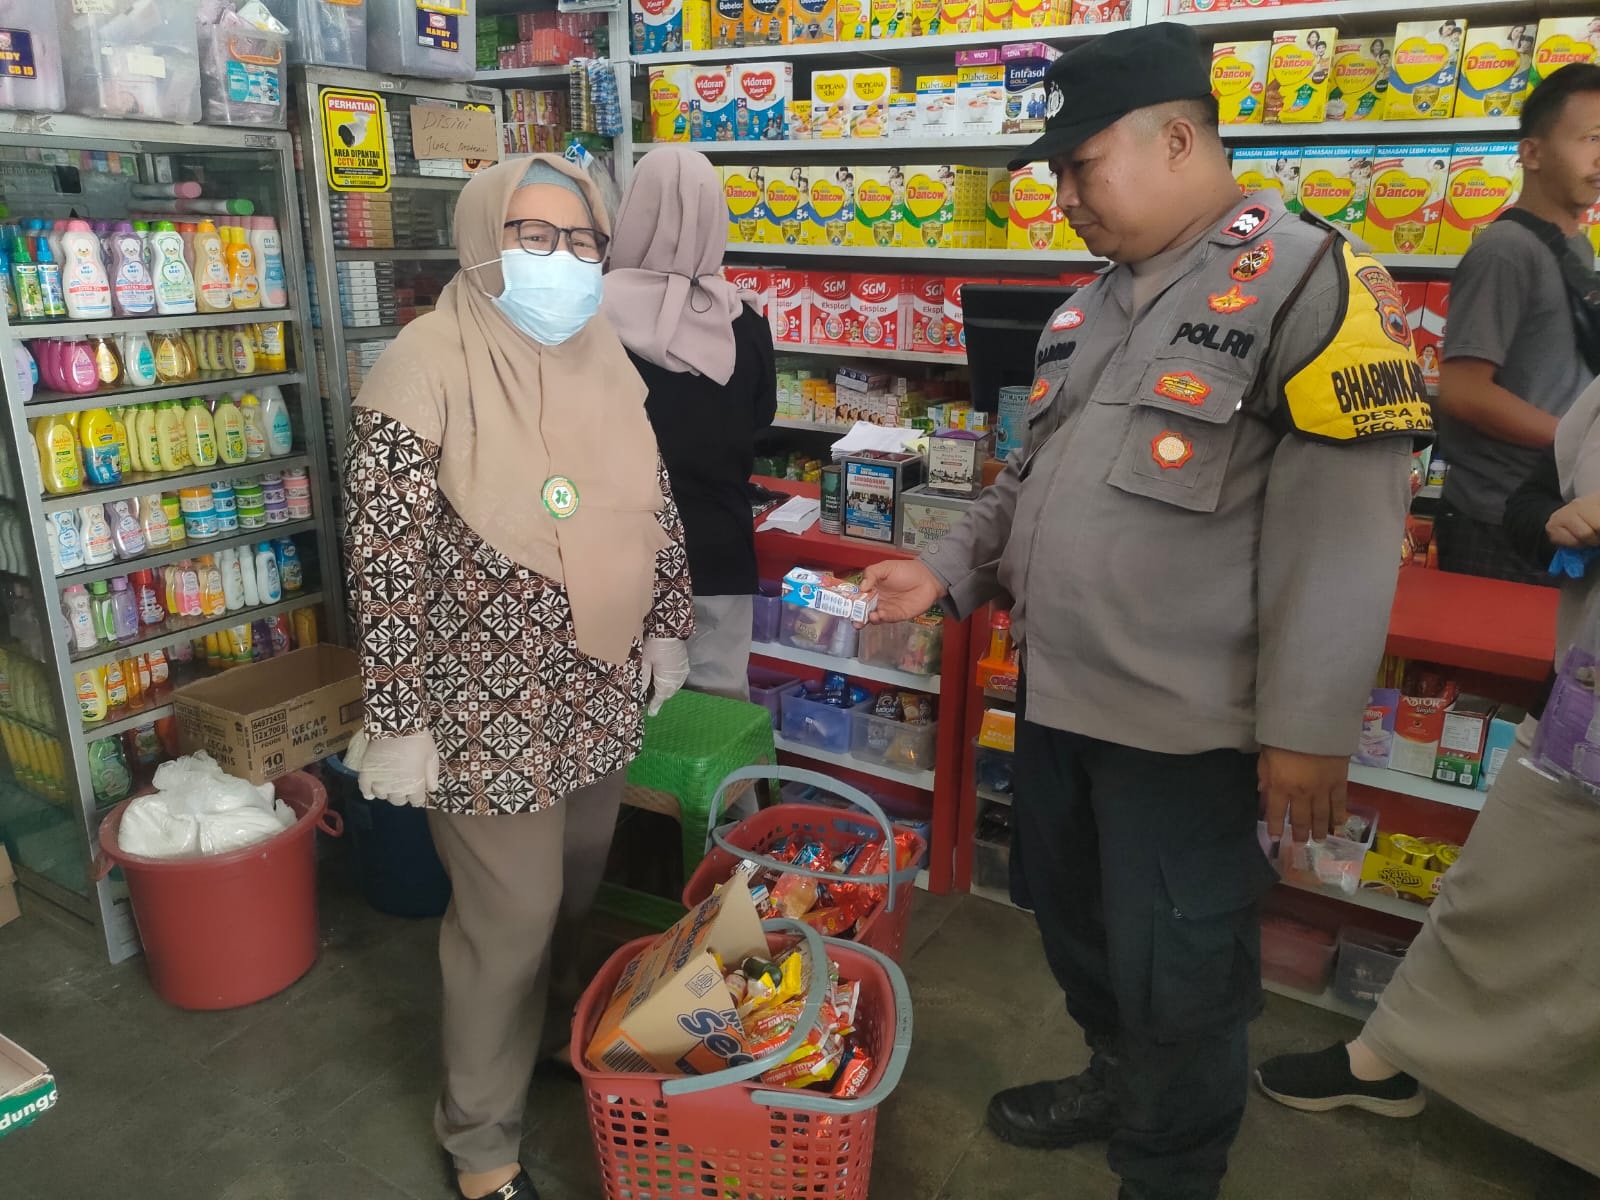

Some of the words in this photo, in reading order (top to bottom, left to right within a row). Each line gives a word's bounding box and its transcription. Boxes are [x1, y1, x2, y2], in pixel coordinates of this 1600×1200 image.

[1273, 56, 1313, 69] Dancow
[1396, 51, 1445, 65] Dancow
[1467, 56, 1517, 71] Dancow
[962, 72, 1000, 82] Diabetasol
[1010, 66, 1046, 79] Entrasol
[1214, 67, 1252, 79] Dancow
[1337, 65, 1377, 77] Dancow
[696, 79, 724, 89] vidoran
[743, 77, 773, 88] vidoran
[1437, 72, 1454, 85] 5+
[1509, 78, 1525, 90] 5+
[328, 99, 376, 112] PERHATIAN
[736, 99, 747, 108] 5+
[333, 149, 350, 158] AREA
[1235, 148, 1264, 158] KEMASAN
[1264, 148, 1282, 157] LEBIH
[1304, 147, 1335, 156] KEMASAN
[1336, 147, 1352, 156] LEBIH
[1352, 147, 1374, 156] HEMAT
[1377, 146, 1409, 156] KEMASAN
[1409, 146, 1428, 155] LEBIH
[1429, 146, 1450, 155] HEMAT
[1455, 145, 1488, 155] KEMASAN
[1488, 144, 1507, 154] LEBIH
[726, 186, 757, 198] Dancow
[908, 186, 945, 200] Dancow
[1014, 189, 1051, 202] Dancow
[1303, 183, 1351, 198] Dancow
[1376, 182, 1427, 197] Dancow
[1452, 182, 1507, 198] Dancow
[768, 190, 798, 202] Dancow
[812, 190, 844, 202] Dancow
[860, 190, 892, 202] Dancow
[753, 208, 765, 218] 5+
[796, 209, 808, 220] 5+
[841, 209, 854, 220] 5+
[890, 209, 904, 221] 3+
[940, 210, 953, 221] 3+
[1051, 209, 1064, 222] 1+
[1345, 207, 1363, 221] 3+
[1422, 209, 1438, 221] 1+
[736, 276, 758, 290] SGM
[823, 280, 846, 293] SGM
[861, 283, 886, 296] SGM
[821, 302, 848, 311] Eksplor
[859, 304, 887, 314] Eksplor
[922, 305, 944, 315] Ekspl
[789, 316, 800, 329] 3+
[884, 319, 896, 333] 1+
[1170, 322, 1255, 359] POLRI
[1352, 407, 1411, 426] DESA
[292, 715, 327, 737] KECAP
[292, 725, 329, 748] MANIS
[264, 752, 283, 769] 10
[851, 1066, 869, 1087] Susu
